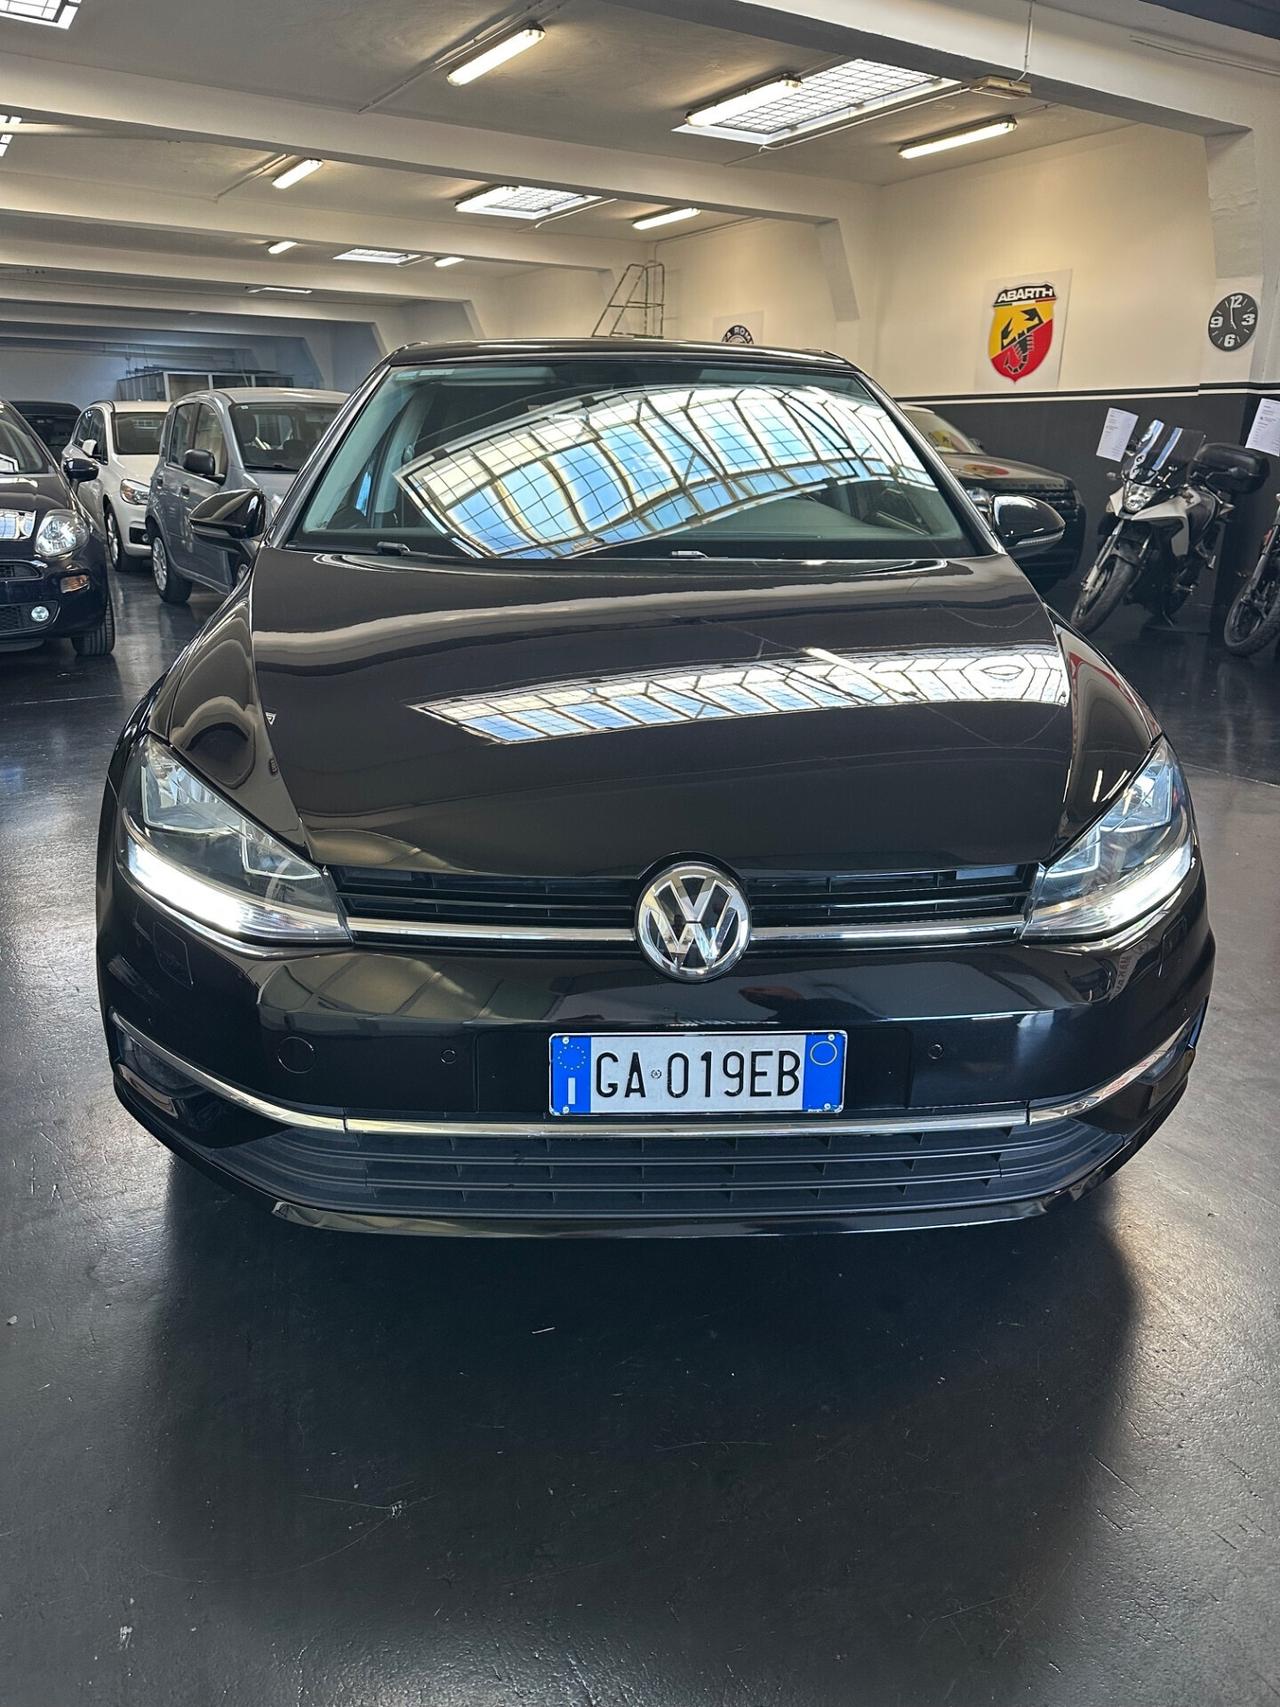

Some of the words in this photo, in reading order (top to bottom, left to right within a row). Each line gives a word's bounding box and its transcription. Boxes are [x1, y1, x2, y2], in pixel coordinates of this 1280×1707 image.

[997, 287, 1053, 302] ABARTH
[1230, 295, 1243, 308] 12
[1210, 316, 1224, 328] 9
[1241, 313, 1256, 326] 3
[1223, 333, 1236, 347] 6
[595, 1051, 647, 1099] GA
